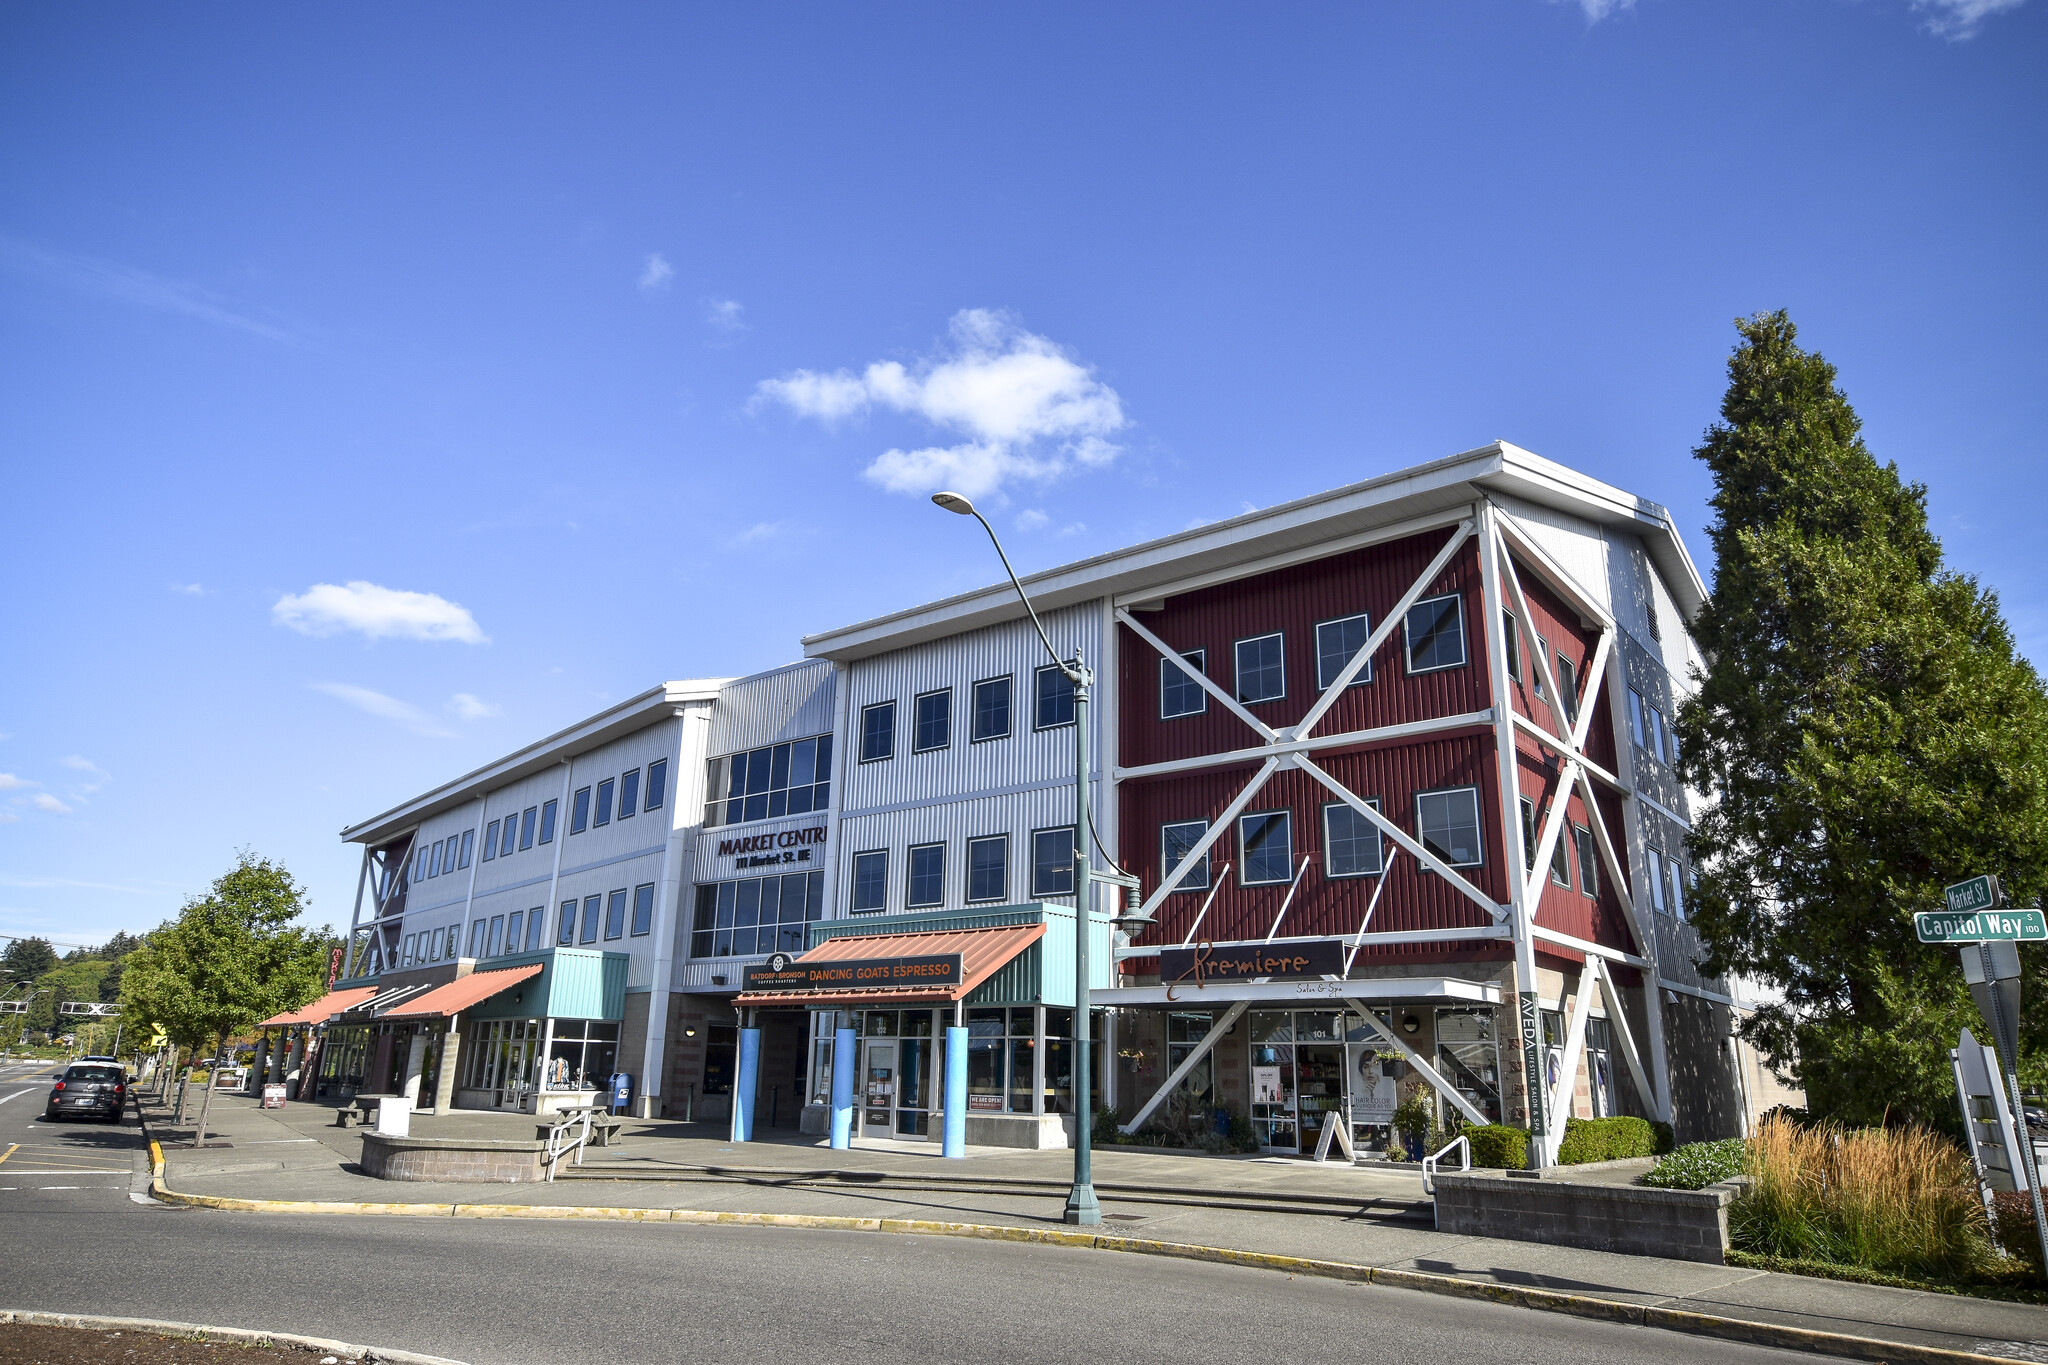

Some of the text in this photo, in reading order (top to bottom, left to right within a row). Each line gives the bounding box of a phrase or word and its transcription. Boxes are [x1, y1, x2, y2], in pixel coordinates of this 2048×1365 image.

[718, 826, 827, 855] MARKET CENTR
[736, 857, 748, 870] 111
[749, 853, 780, 867] Market
[783, 850, 796, 864] St.
[1948, 882, 1986, 910] Market St
[1921, 913, 2033, 939] Capitol Way S
[2025, 925, 2040, 933] 100
[328, 948, 343, 992] MERCAT
[750, 971, 807, 981] BATDORF BRONSON
[809, 963, 951, 981] DANCING GOATS ESPRESSO
[1296, 982, 1343, 997] Salon & Spa
[1313, 1030, 1326, 1038] 101
[1521, 997, 1536, 1050] AVEDA
[1528, 1051, 1538, 1084] LIFESTYLE
[1371, 1097, 1391, 1105] COLOR
[1530, 1086, 1540, 1109] SALON
